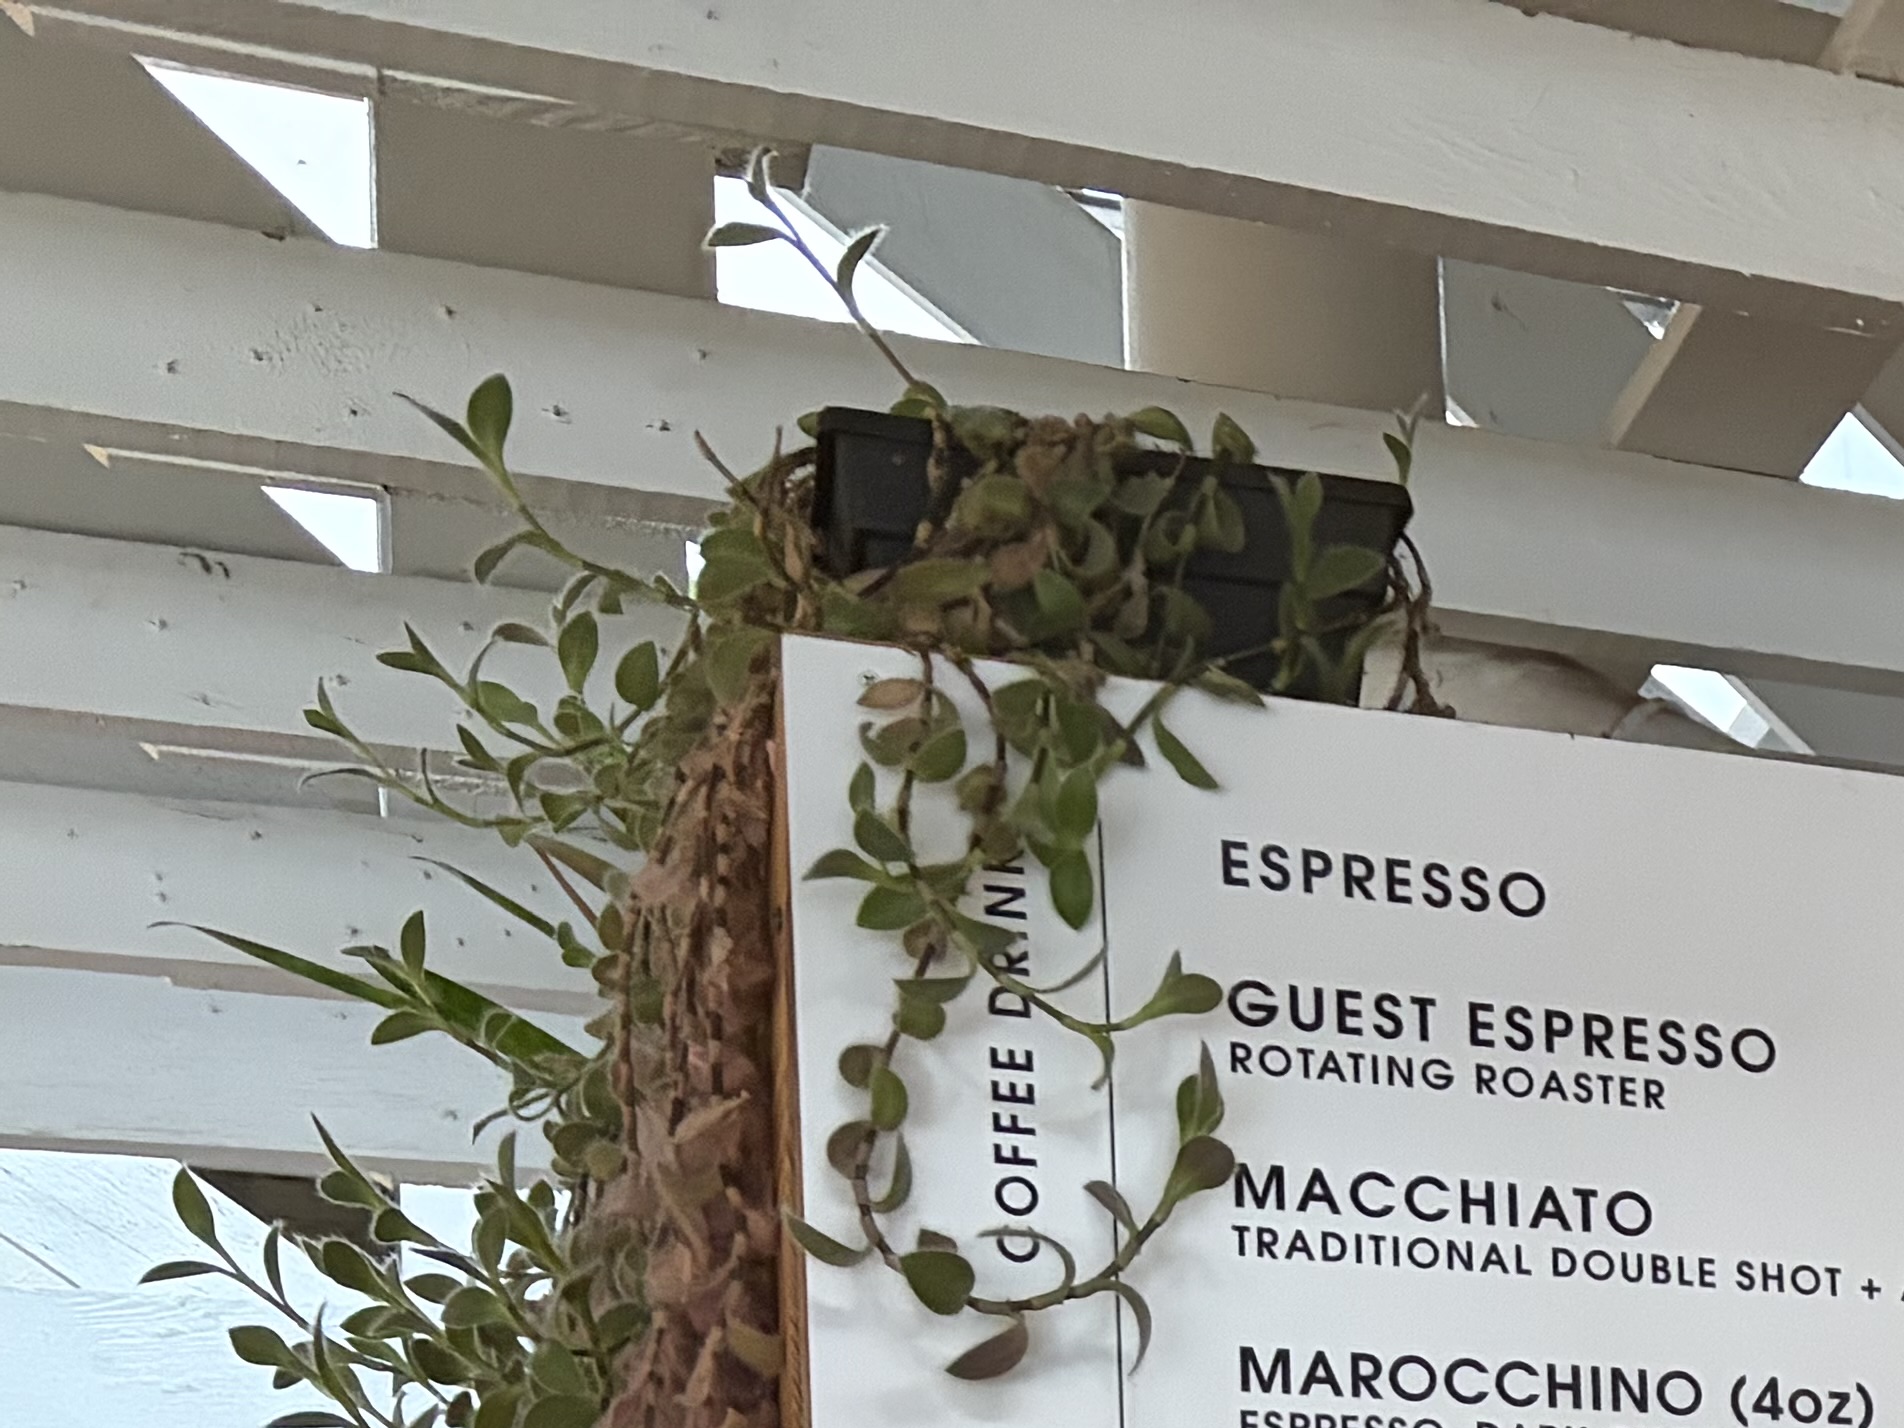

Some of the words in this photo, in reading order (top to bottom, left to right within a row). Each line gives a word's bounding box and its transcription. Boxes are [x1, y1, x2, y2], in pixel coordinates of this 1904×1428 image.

[1219, 838, 1548, 919] ESPRESSO
[1225, 978, 1438, 1044] GUEST
[1466, 1000, 1778, 1075] ESPRESSO
[1228, 1039, 1456, 1092] ROTATING
[1473, 1061, 1667, 1112] ROASTER
[987, 1045, 1042, 1265] COFFEE
[1232, 1161, 1654, 1239] MACCHIATO
[1229, 1223, 1534, 1278] TRADITIONAL
[1550, 1245, 1718, 1290] DOUBLE
[1734, 1258, 1843, 1298] SHOT
[1238, 1344, 1704, 1418] MAROCCHINO
